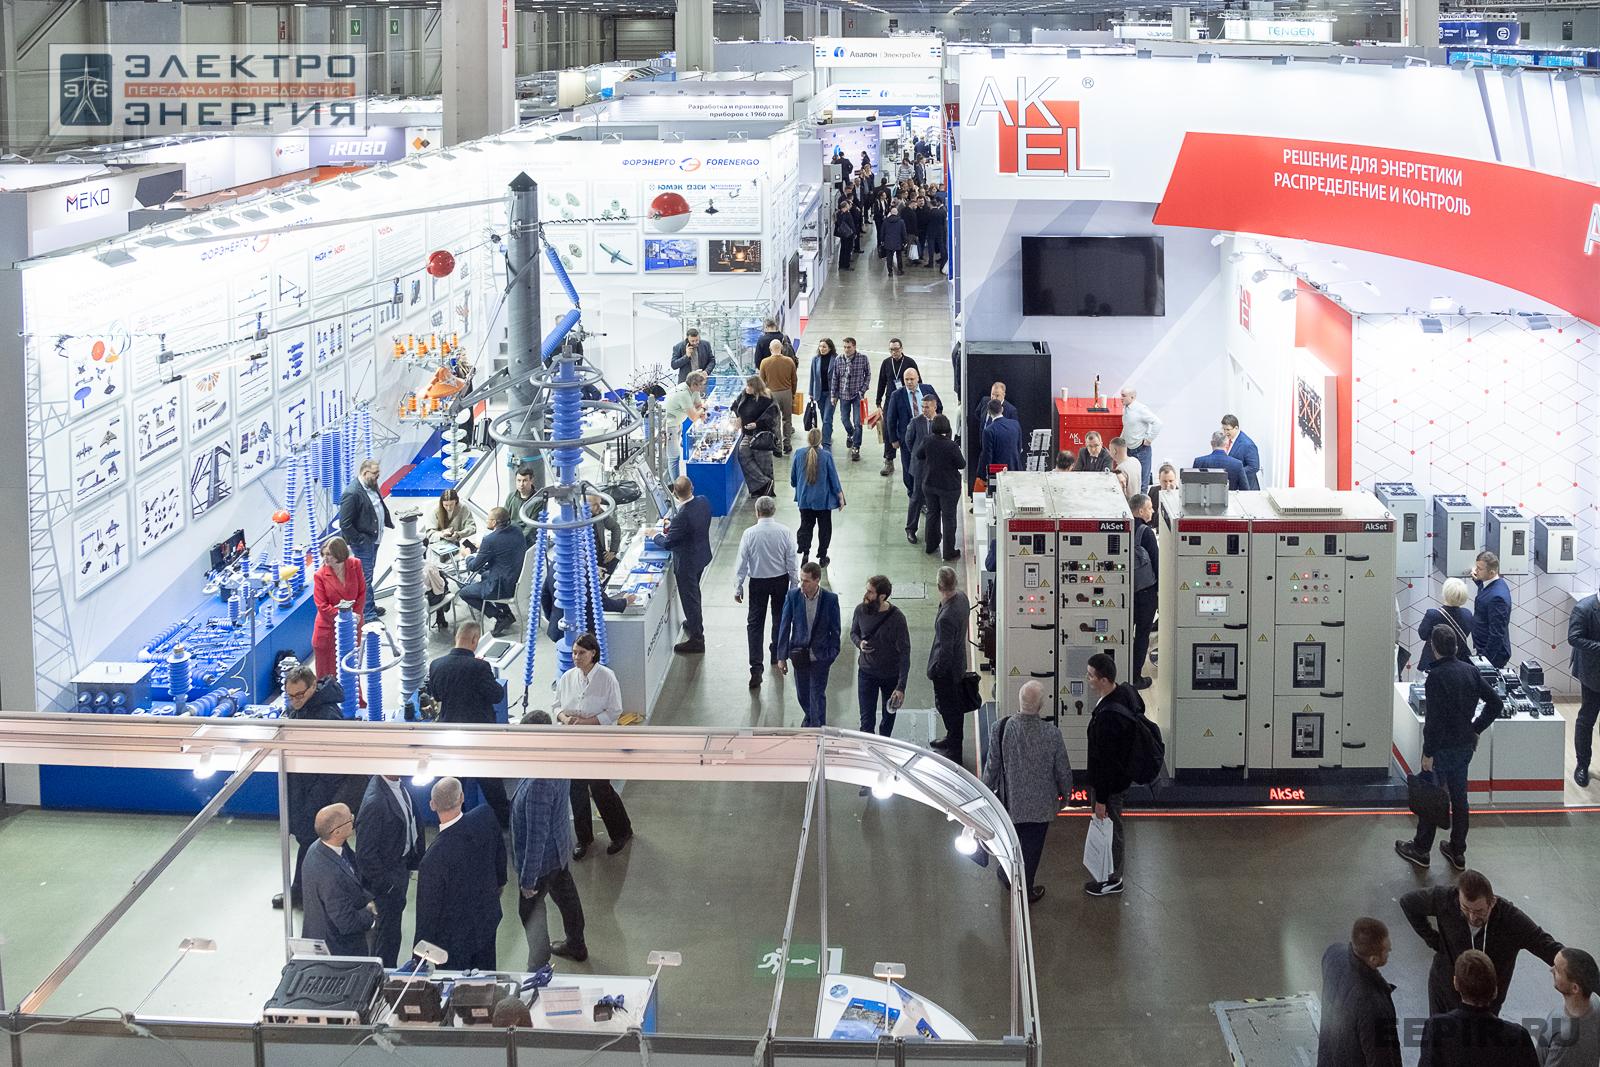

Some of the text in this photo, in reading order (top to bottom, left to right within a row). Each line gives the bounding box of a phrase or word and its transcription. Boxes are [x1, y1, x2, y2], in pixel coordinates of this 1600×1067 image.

[1268, 26, 1316, 37] TENGEN
[849, 50, 922, 59] Авалон ЭлектроТех
[688, 103, 728, 111] Разработка
[328, 140, 388, 156] iROBO
[622, 157, 676, 166] ФОРЭНЕРГО
[706, 158, 760, 166] FORENERGO
[1283, 148, 1463, 188] РЕШЕНИЕ ДЛЯ ЭНЕРГЕТИКИ
[1273, 171, 1472, 217] РАСПРЕДЕЛЕНИЕ И КОНТРОЛЬ
[1100, 522, 1124, 530] AkSet
[1364, 522, 1388, 531] AkSet
[1269, 787, 1306, 801] AkSet
[300, 975, 346, 996] GATOR
